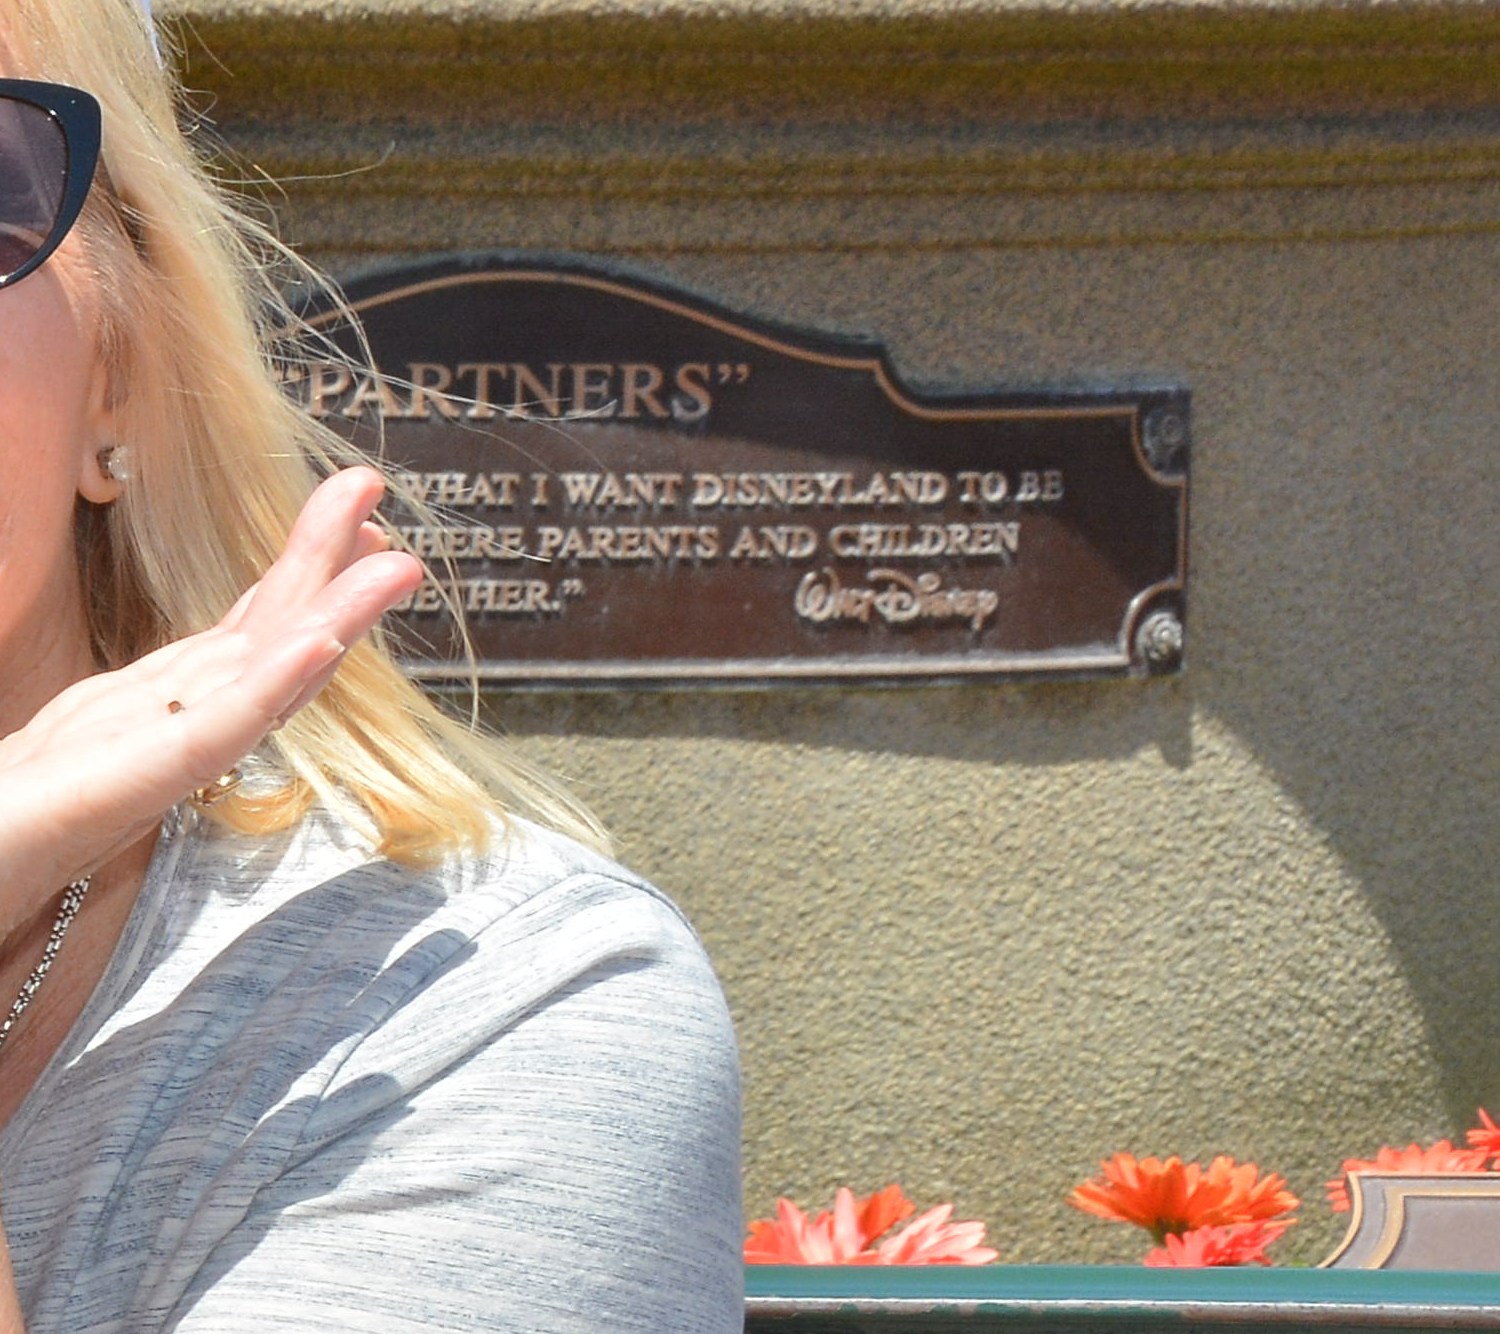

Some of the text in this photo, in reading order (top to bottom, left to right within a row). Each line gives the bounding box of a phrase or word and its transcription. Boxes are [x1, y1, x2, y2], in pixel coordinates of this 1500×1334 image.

[394, 469, 1065, 506] WHAT I WANT DISNEYLAND TO BE
[537, 525, 719, 560] PARENTS
[730, 525, 819, 559] AND
[828, 522, 1022, 558] CHILDREN
